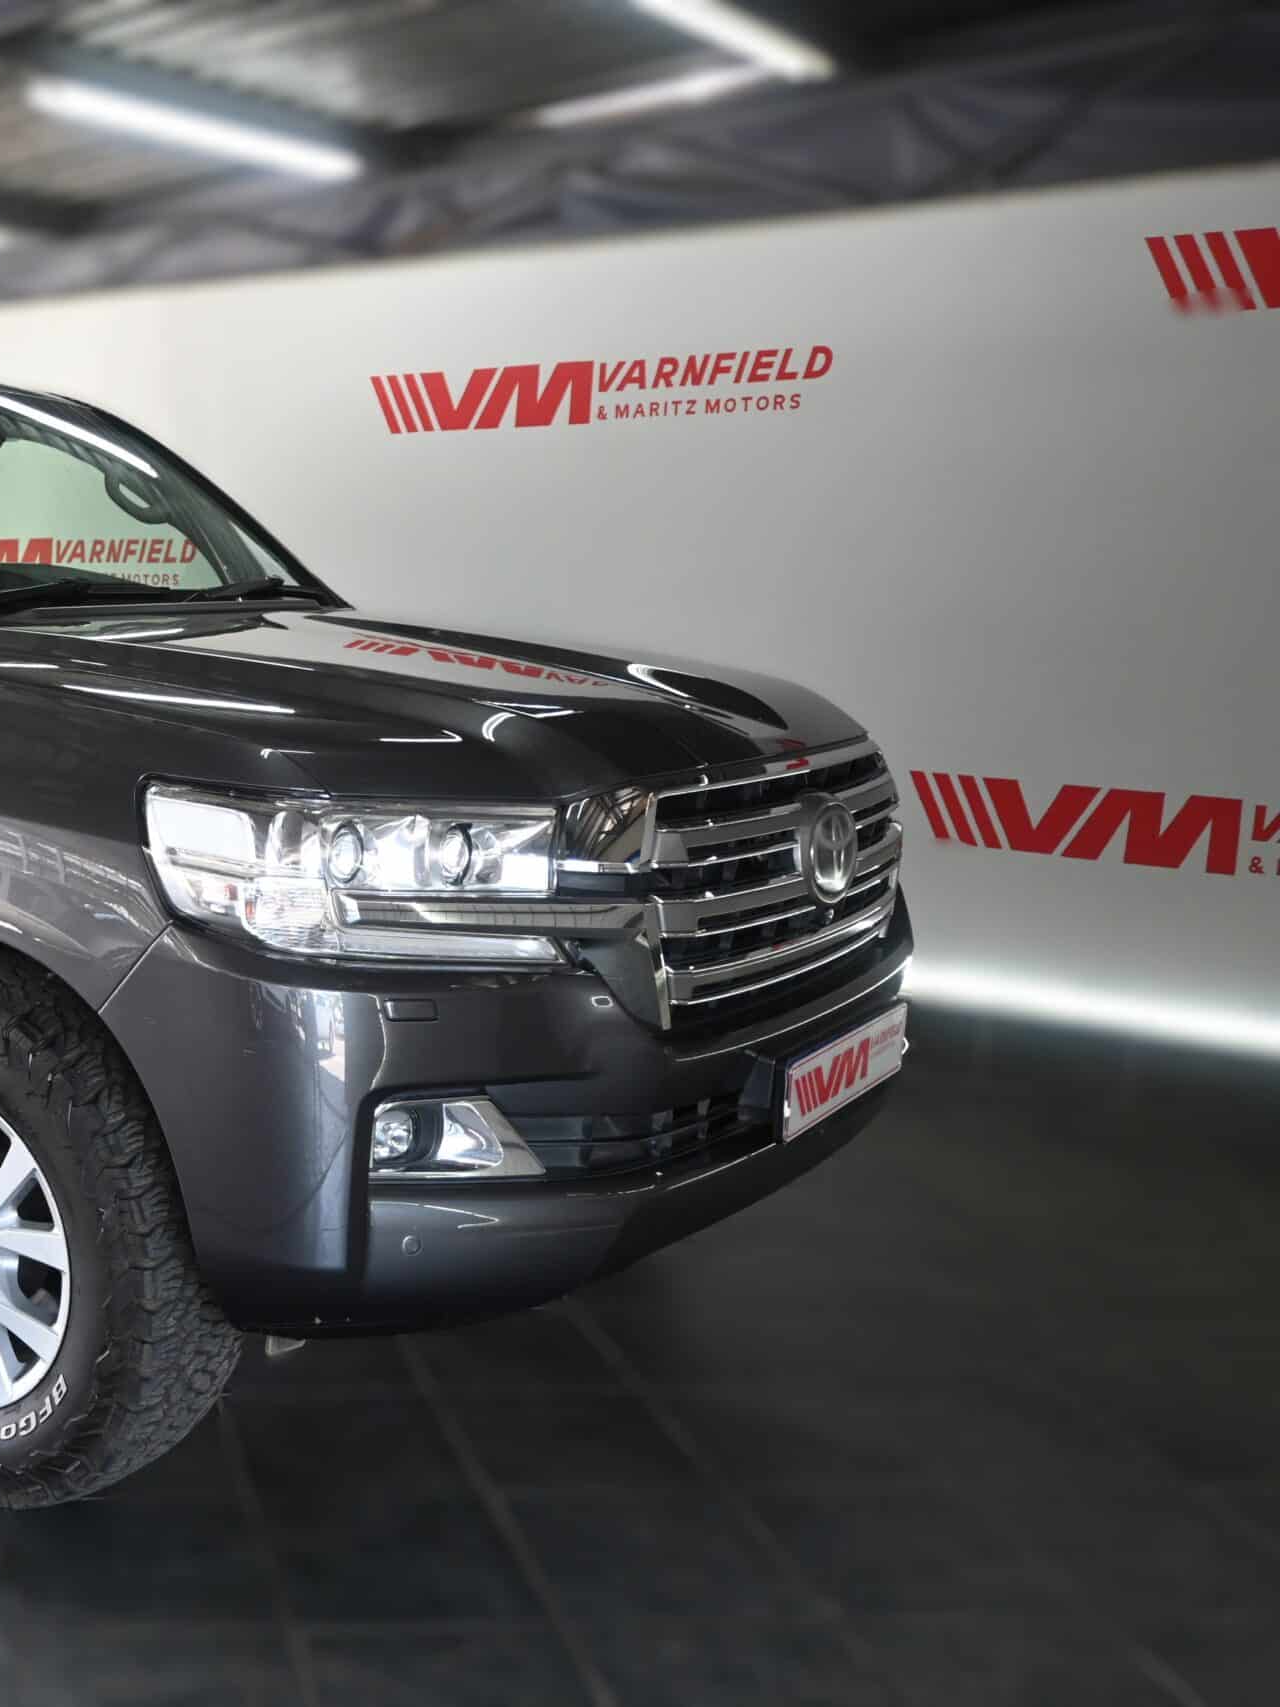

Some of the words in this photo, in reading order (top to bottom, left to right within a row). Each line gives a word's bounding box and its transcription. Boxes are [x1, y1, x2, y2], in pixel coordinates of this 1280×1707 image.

[597, 344, 834, 392] VARNFIELD
[420, 359, 594, 431] VM
[597, 405, 608, 420] &
[615, 399, 697, 419] MARITZ
[705, 393, 802, 415] MOTORS
[55, 538, 198, 564] VARNFIELD
[982, 777, 1243, 876] VM
